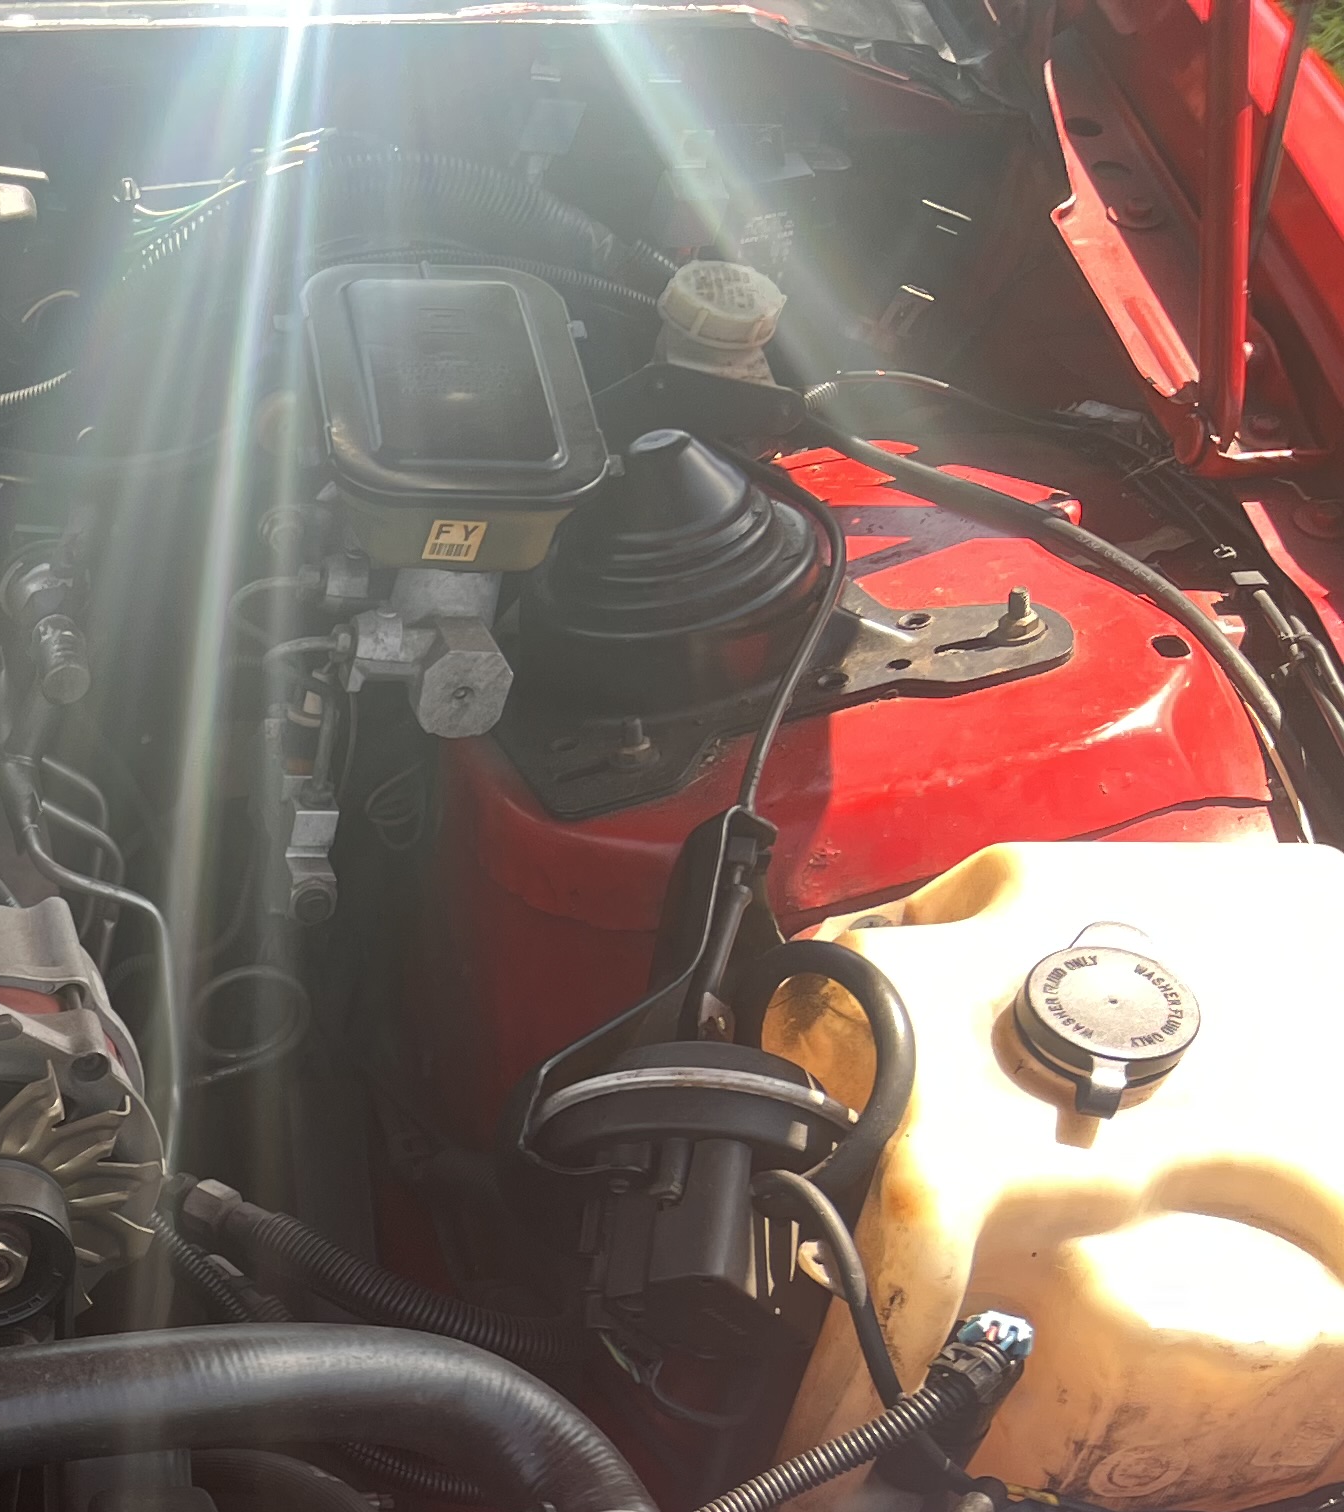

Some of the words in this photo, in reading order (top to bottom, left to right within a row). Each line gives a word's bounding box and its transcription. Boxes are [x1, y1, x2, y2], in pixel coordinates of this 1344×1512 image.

[1063, 954, 1098, 970] ONLY
[1133, 963, 1182, 1006] WASHER
[1160, 1008, 1184, 1036] FLUID
[1130, 1031, 1165, 1049] ONLY
